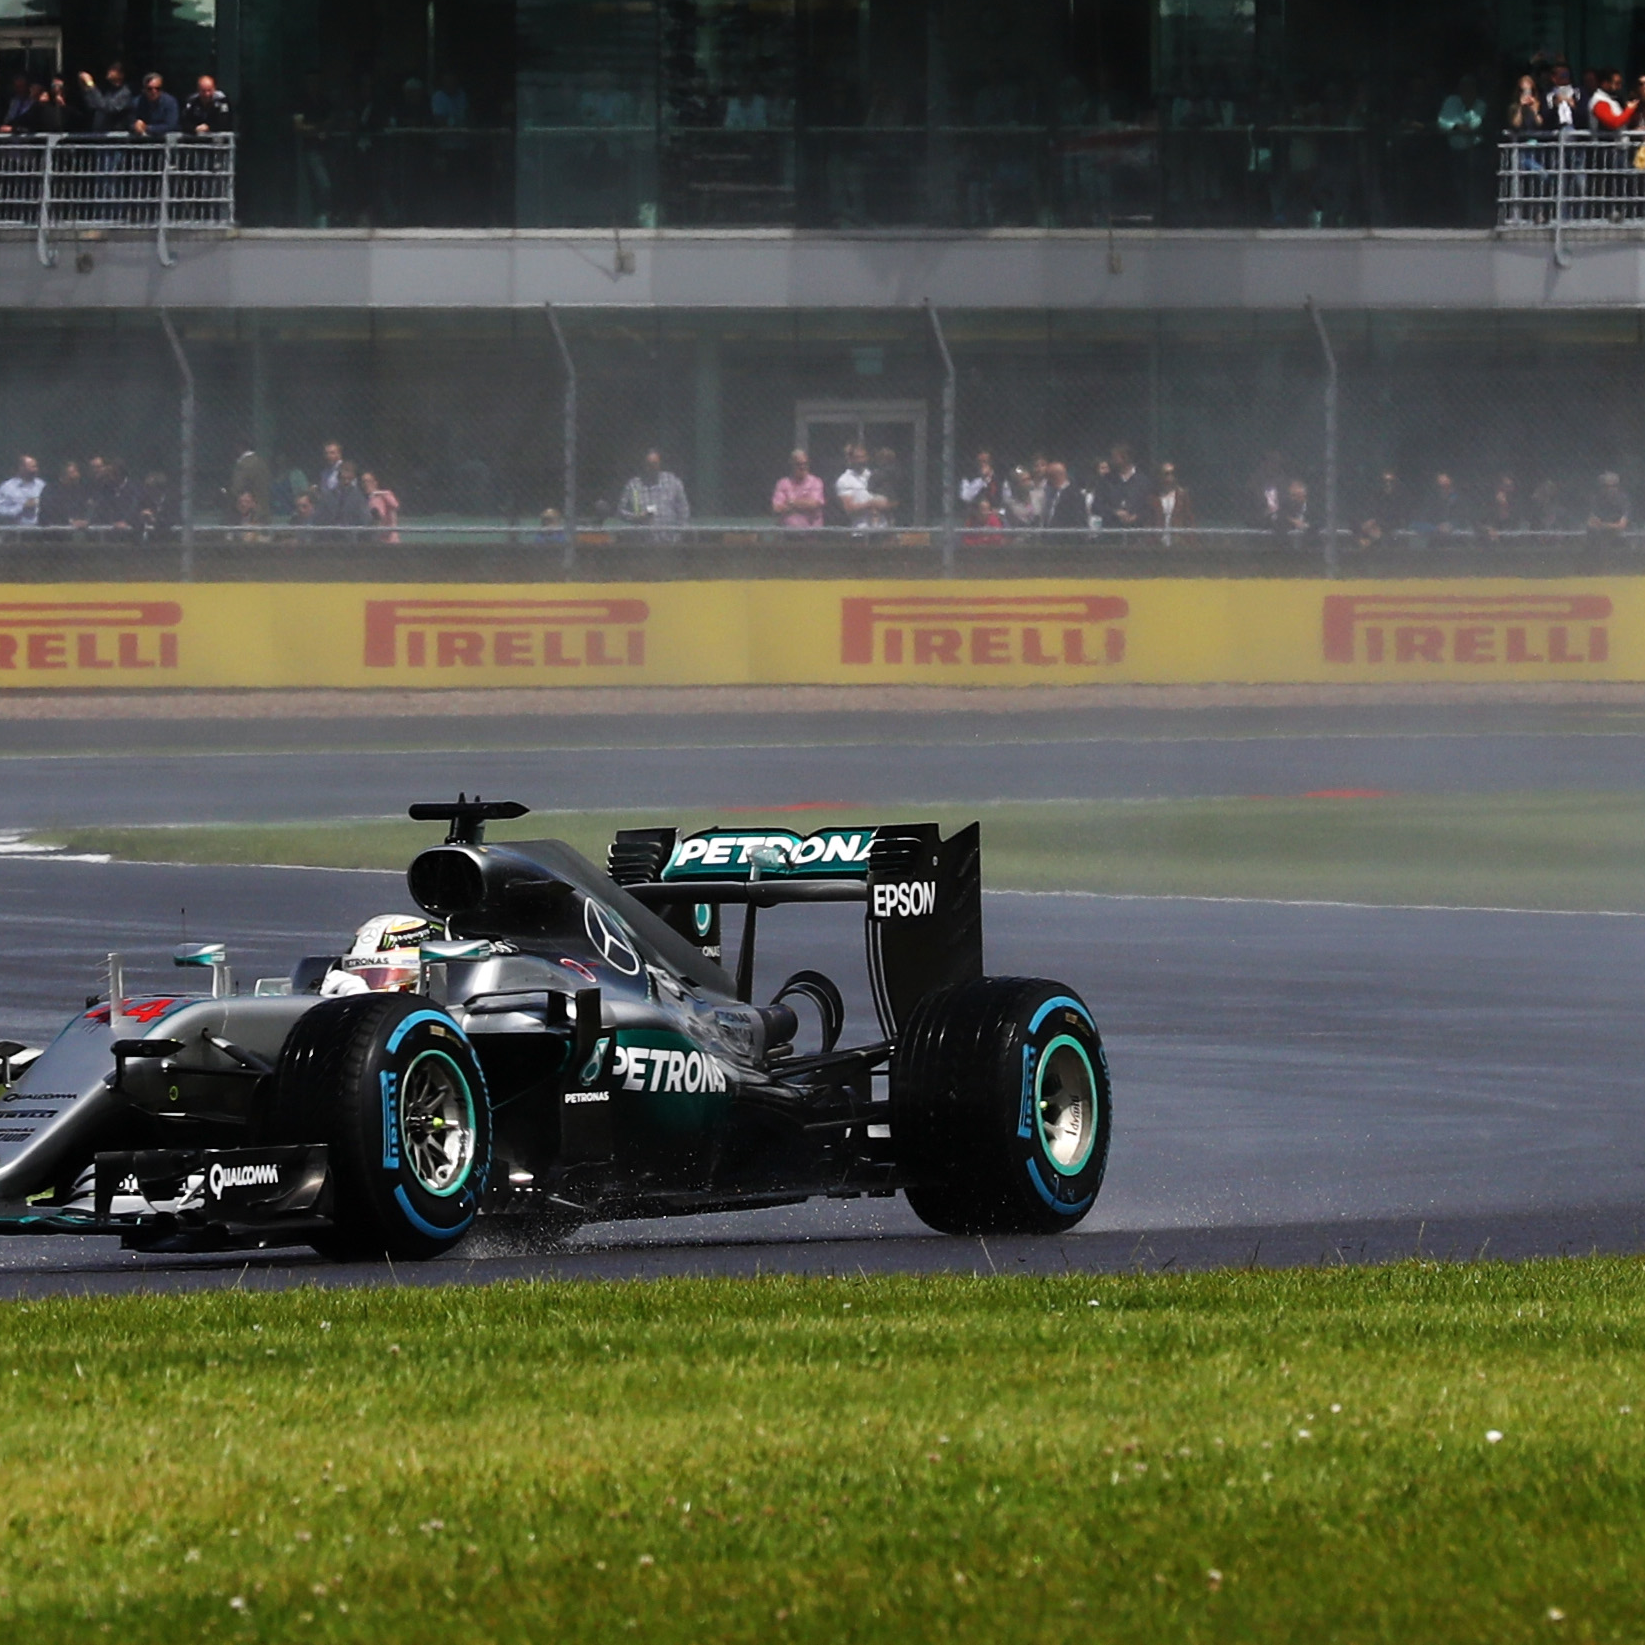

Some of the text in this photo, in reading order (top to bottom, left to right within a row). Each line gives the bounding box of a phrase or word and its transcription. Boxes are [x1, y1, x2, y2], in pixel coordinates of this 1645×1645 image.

[365, 599, 650, 668] PIRELLI
[840, 595, 1129, 665] PIRELLI
[1323, 594, 1613, 664] PIRELLI
[674, 833, 874, 867] PETRONA
[873, 881, 936, 918] EPSON
[2, 1092, 78, 1103] QUALCOMM
[564, 1091, 610, 1104] PETRONAS
[209, 1162, 279, 1200] QUALCOMM
